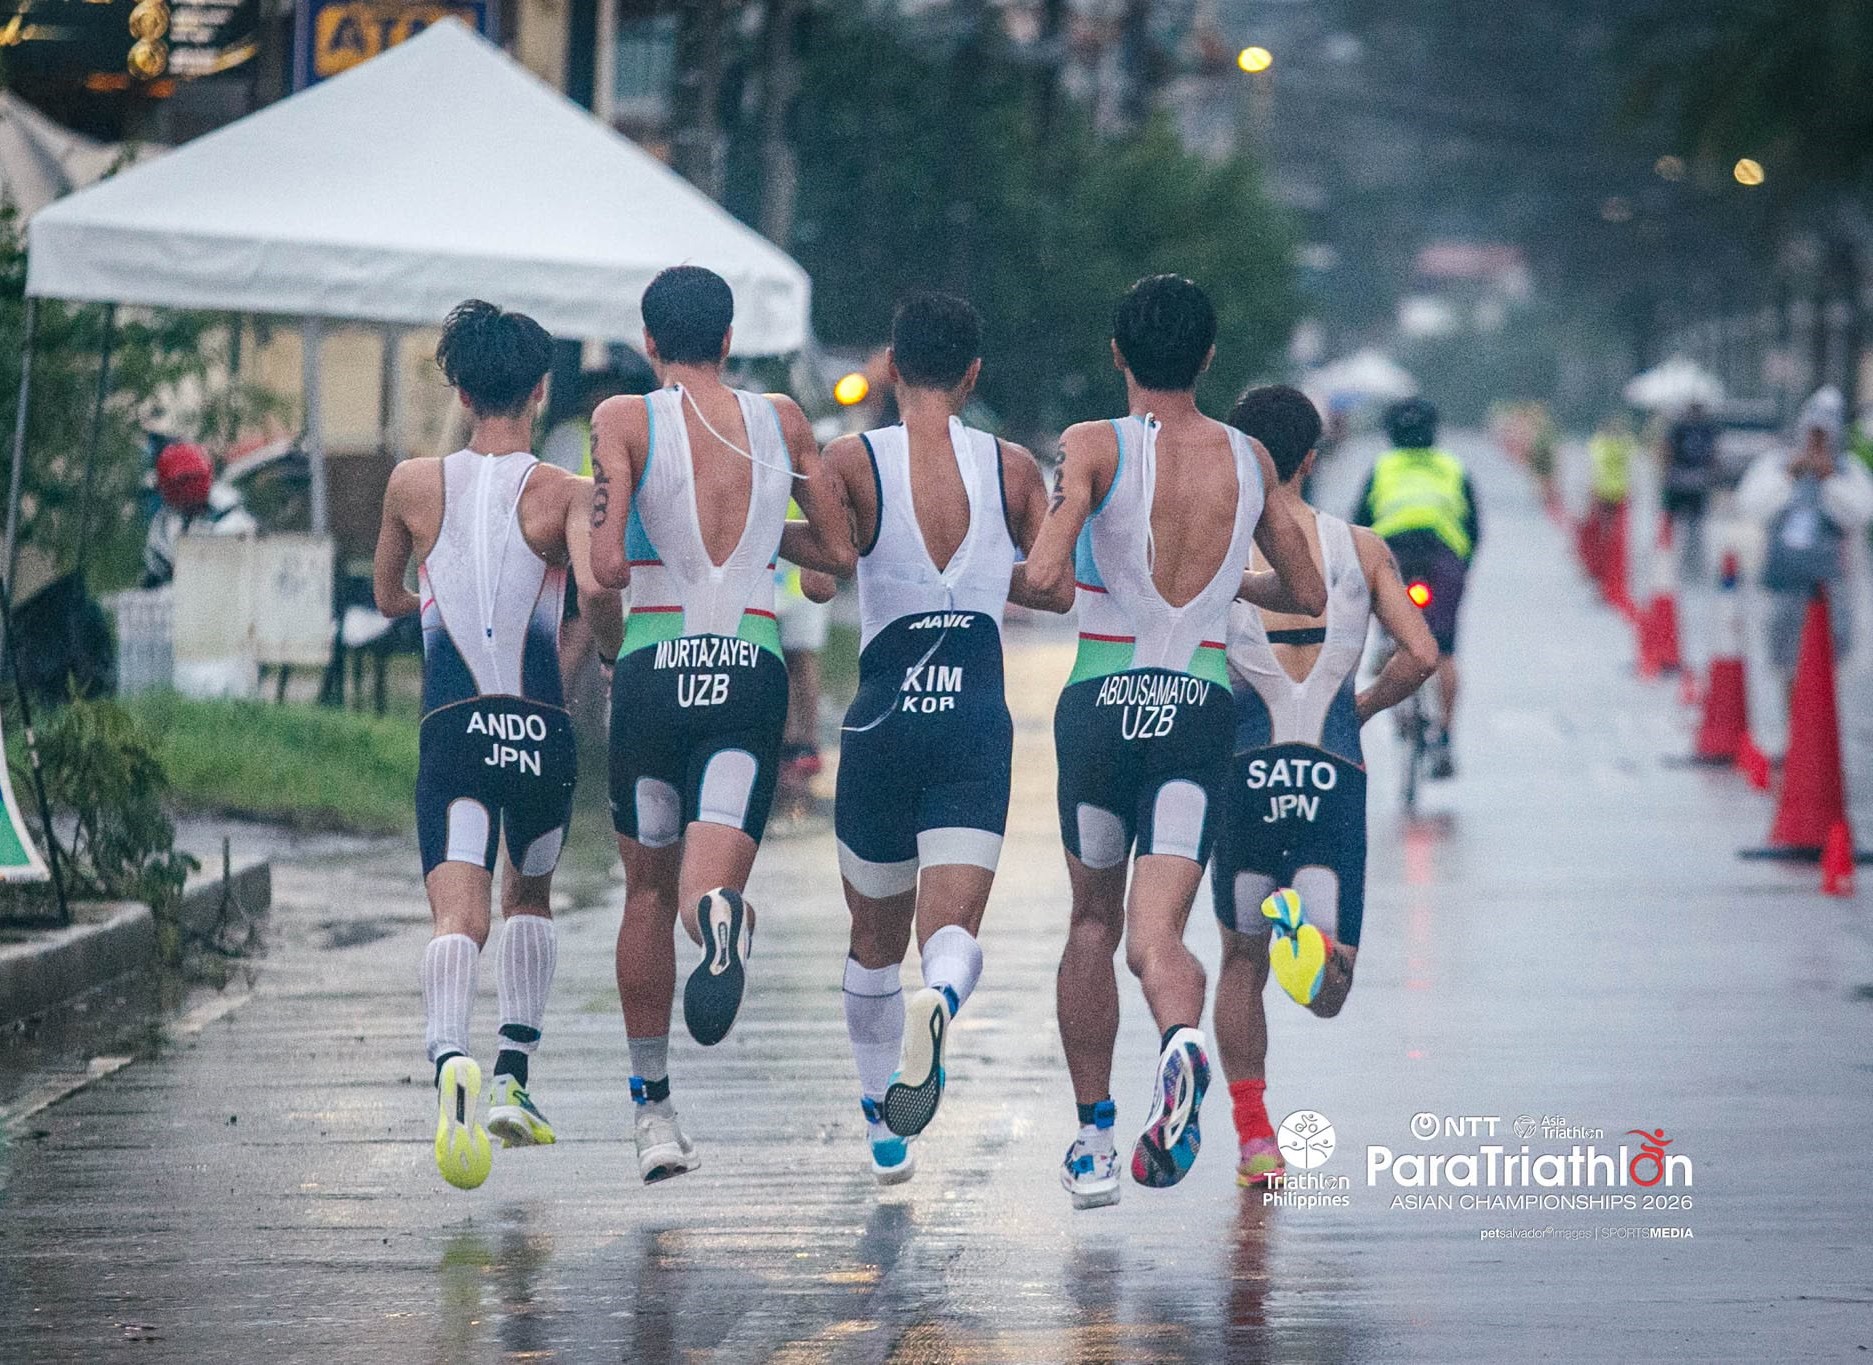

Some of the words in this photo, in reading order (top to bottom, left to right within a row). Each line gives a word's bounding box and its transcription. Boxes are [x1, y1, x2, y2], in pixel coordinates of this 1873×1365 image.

[908, 614, 976, 630] MAVIC
[653, 637, 760, 670] MURTAZAYEV
[677, 673, 730, 708] UZB
[901, 665, 964, 693] KIM
[1095, 674, 1210, 707] ABDUSAMATOV
[901, 696, 955, 714] KOR
[466, 711, 547, 742] ANDO
[1121, 704, 1178, 741] UZB
[484, 743, 541, 777] JPN
[1246, 758, 1337, 790] SATO
[1262, 793, 1320, 823] JPN
